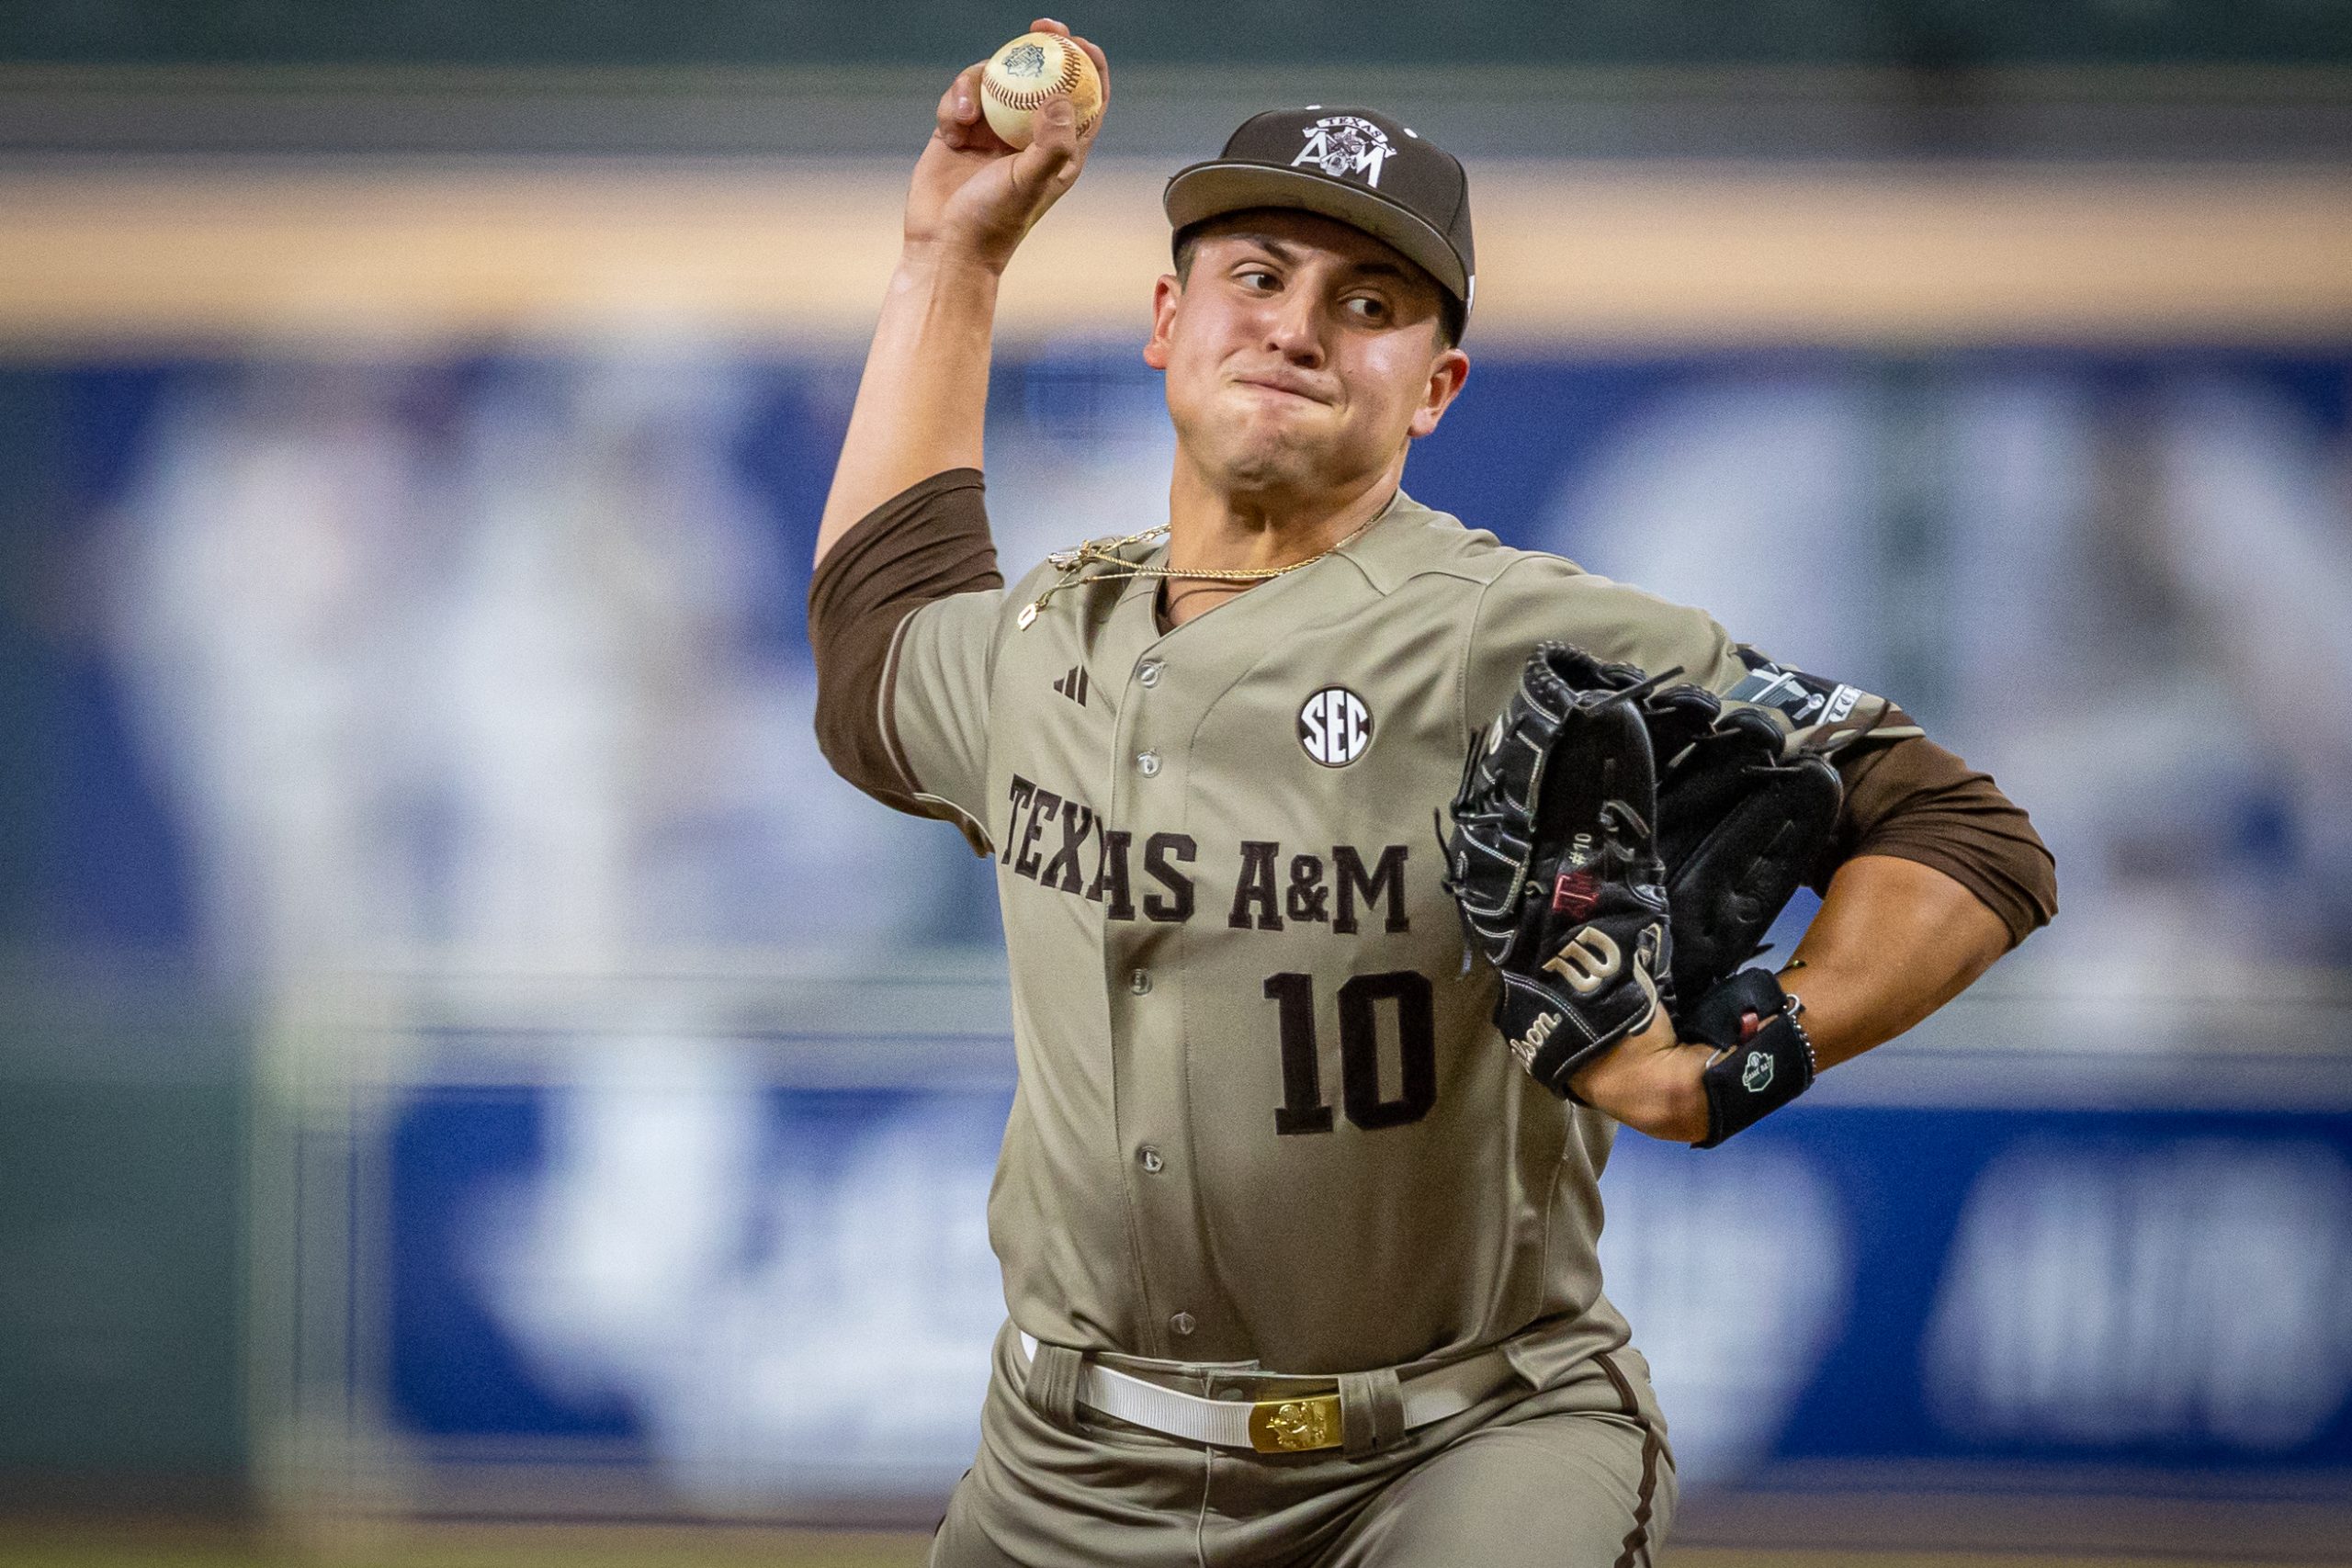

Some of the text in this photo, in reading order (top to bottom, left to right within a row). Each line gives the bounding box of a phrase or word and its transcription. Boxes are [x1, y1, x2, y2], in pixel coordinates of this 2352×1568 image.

[1326, 117, 1384, 138] TEXAS
[1300, 689, 1369, 764] SEC
[1001, 773, 1410, 934] TEXAS A&M
[1568, 832, 1592, 865] #10
[1263, 970, 1438, 1135] 10
